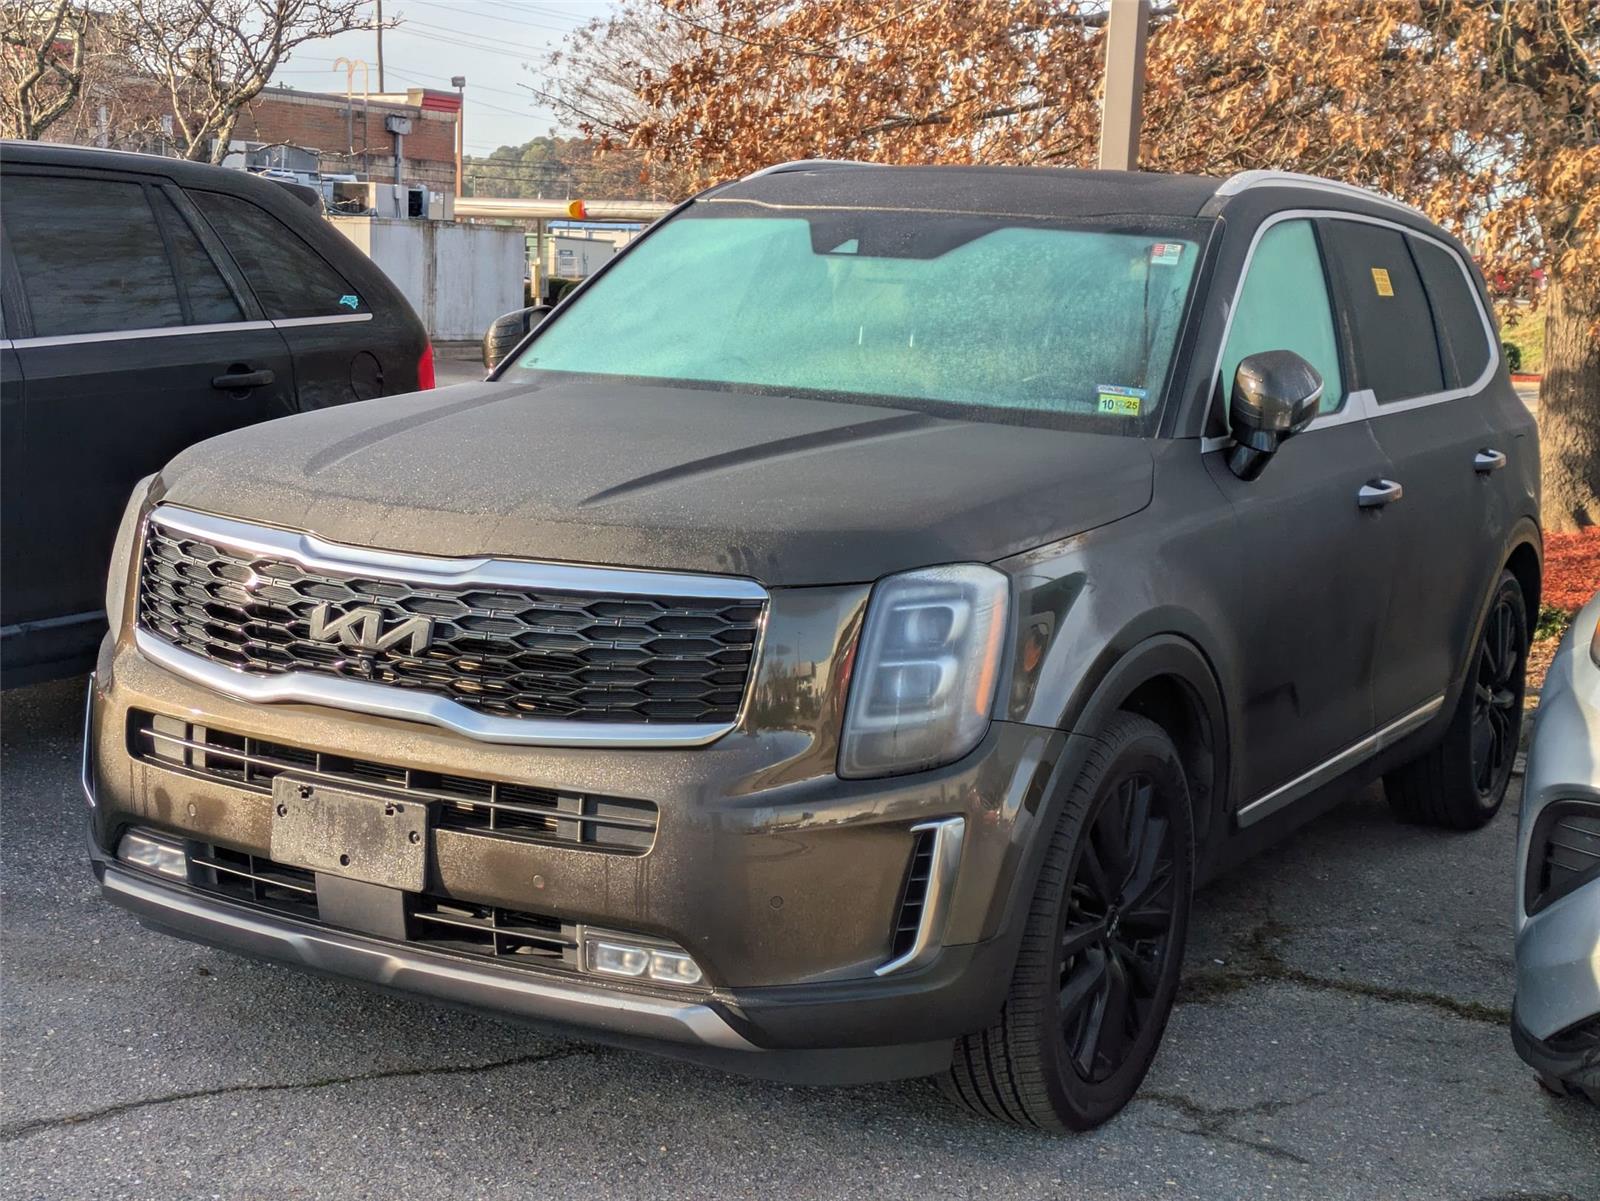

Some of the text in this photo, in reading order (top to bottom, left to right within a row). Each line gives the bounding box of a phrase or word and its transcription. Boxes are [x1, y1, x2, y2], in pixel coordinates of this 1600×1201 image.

[1102, 399, 1138, 410] 10 25
[309, 601, 435, 657] KIA
